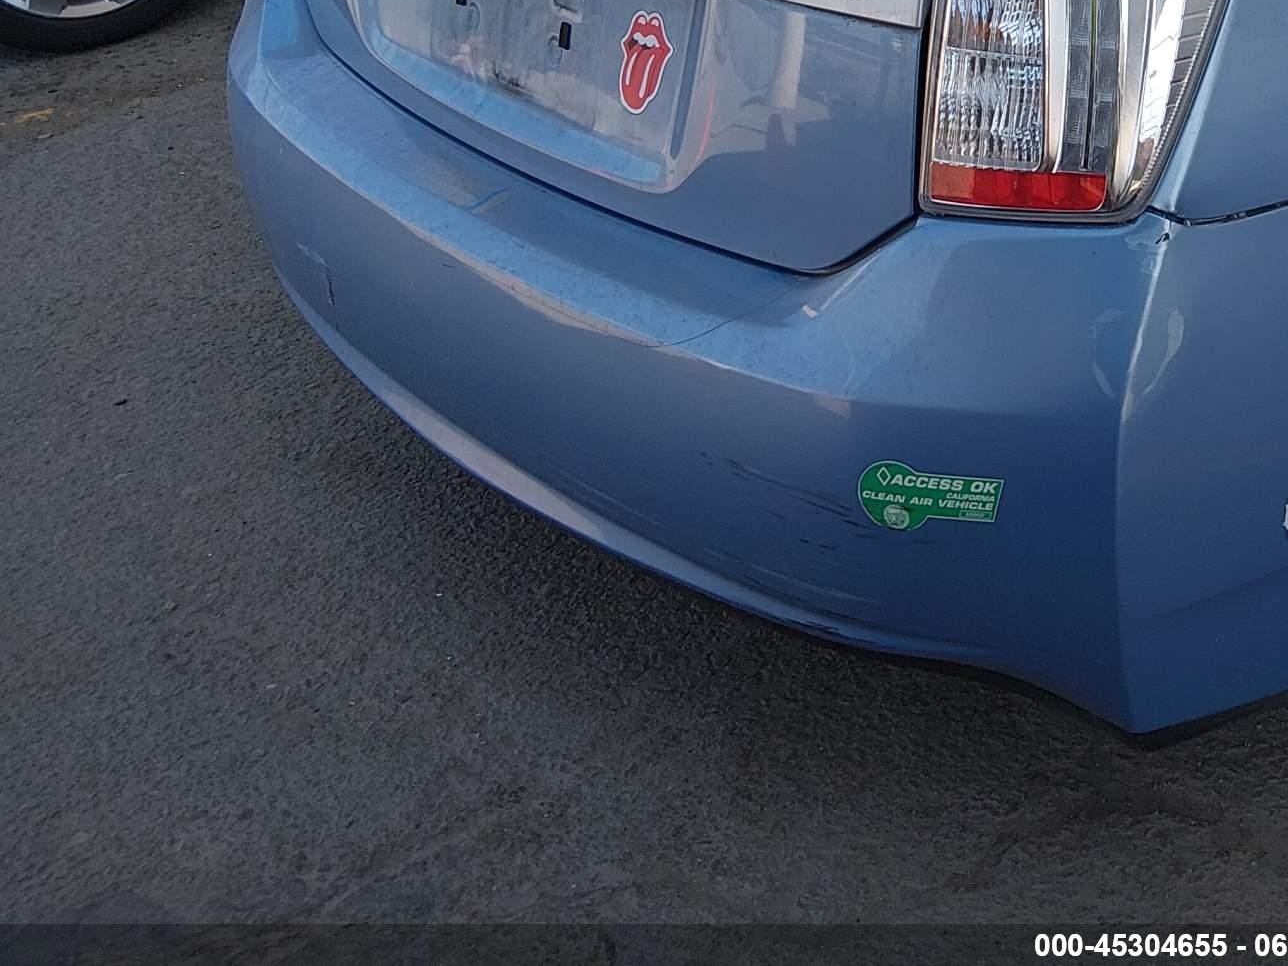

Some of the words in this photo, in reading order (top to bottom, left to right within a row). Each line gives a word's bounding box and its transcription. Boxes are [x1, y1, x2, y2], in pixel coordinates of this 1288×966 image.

[890, 474, 964, 492] ACCESS
[970, 481, 998, 494] OK
[862, 490, 905, 504] CLEAN
[909, 496, 933, 506] AIR
[938, 499, 994, 511] VEHICLE
[946, 492, 995, 503] CALIFORNIA
